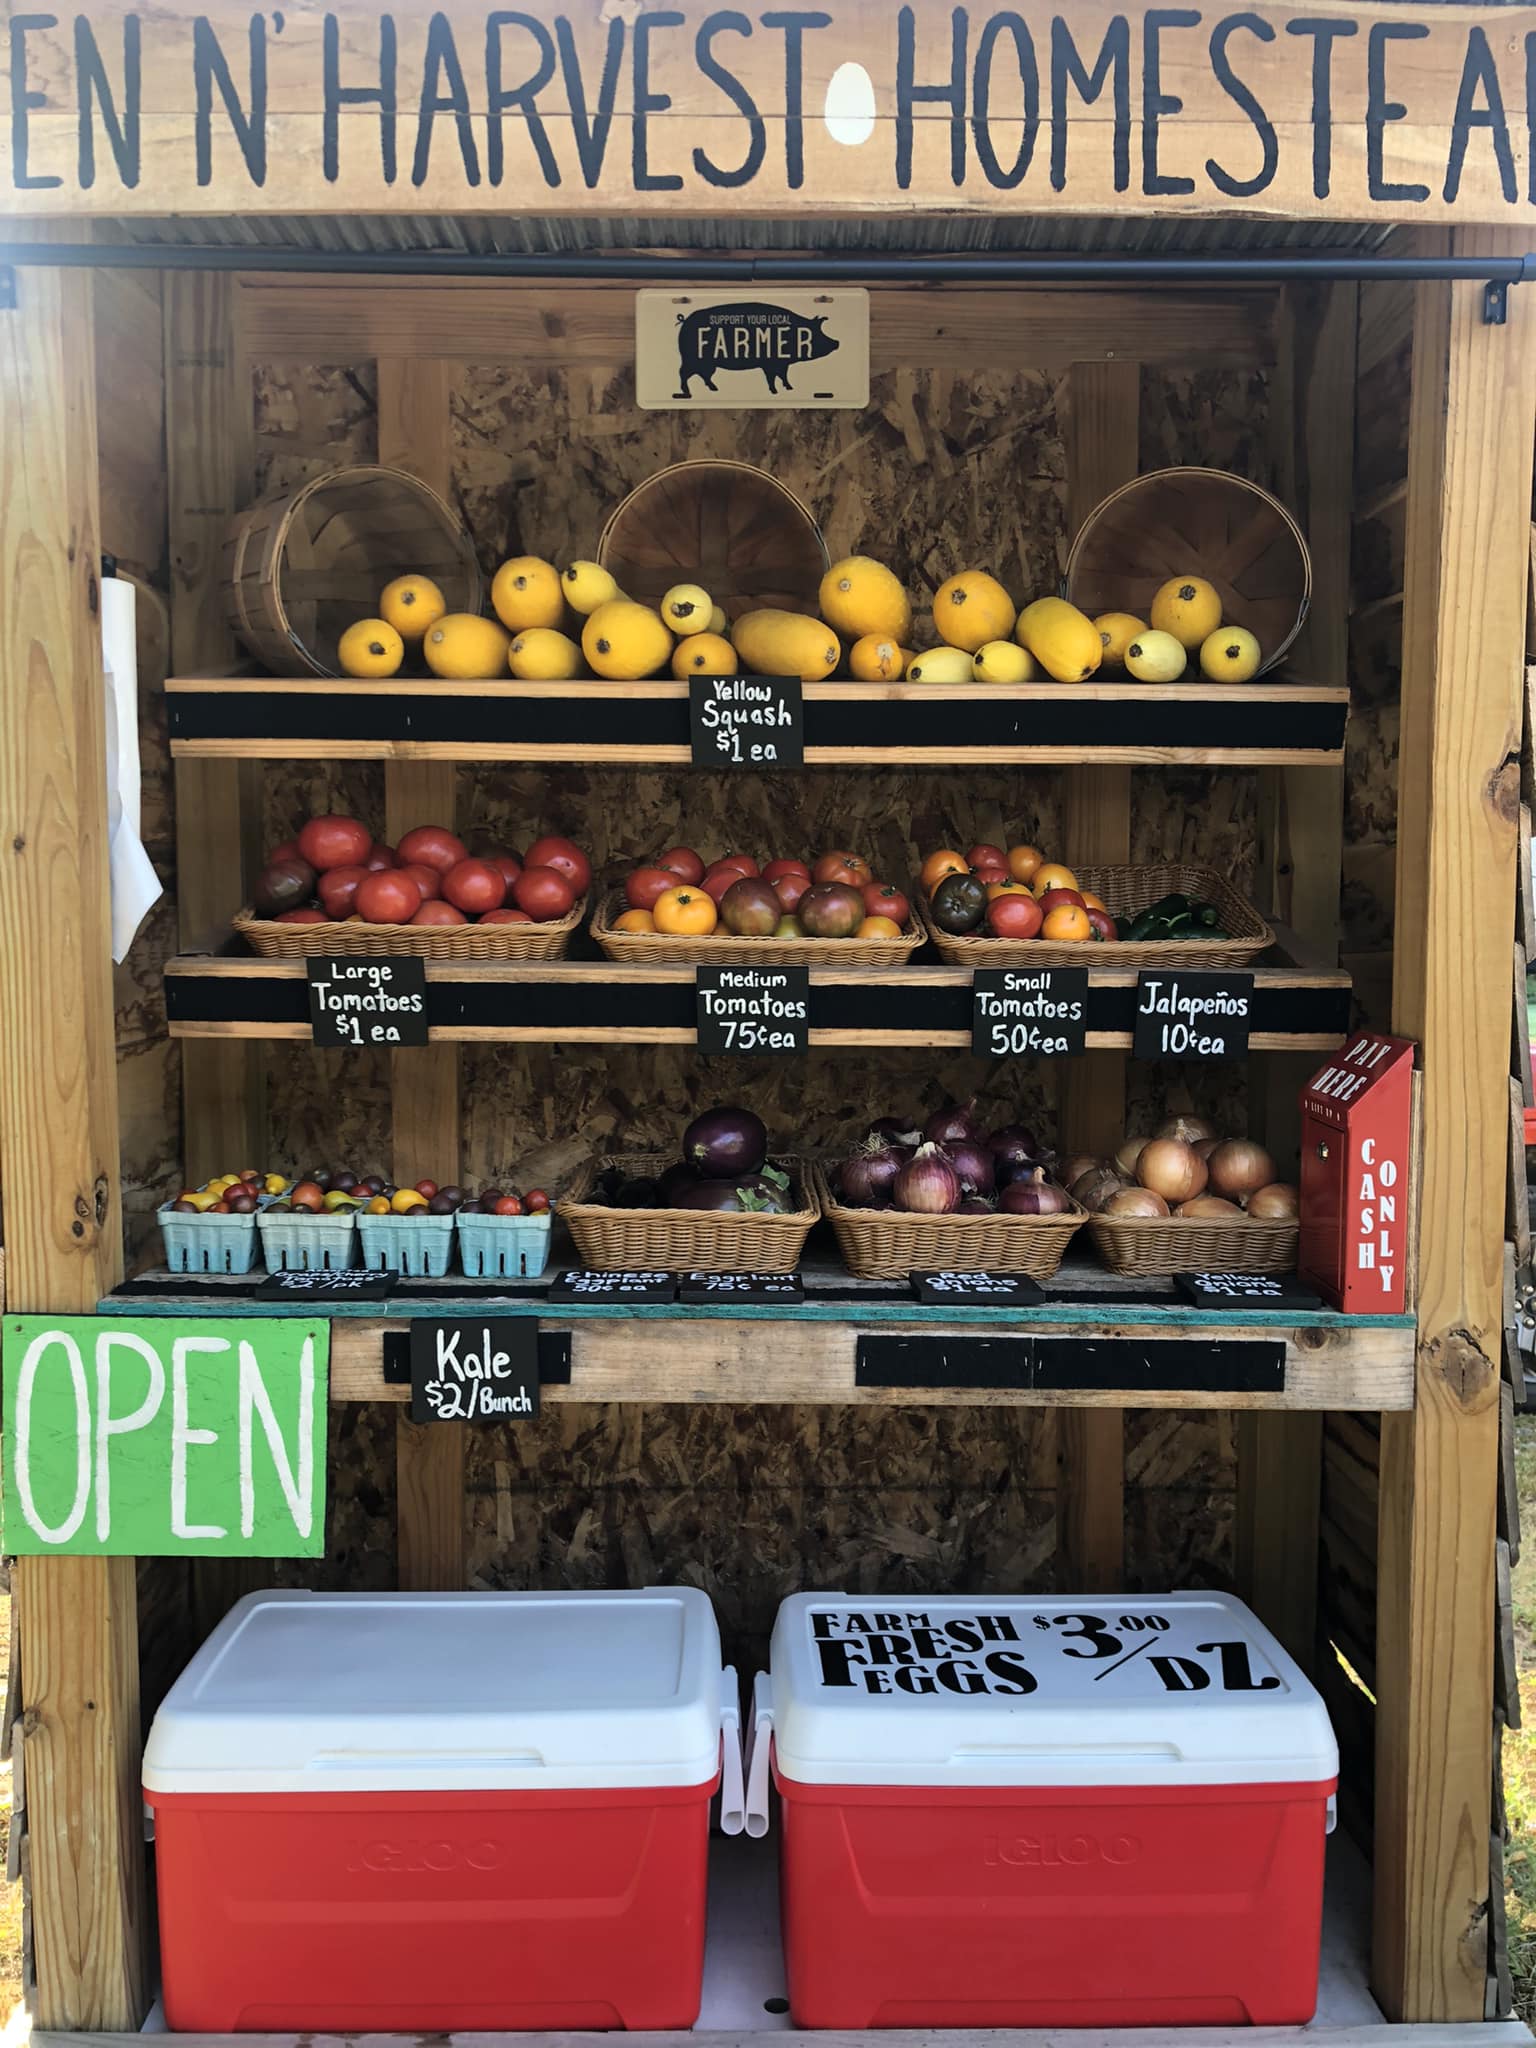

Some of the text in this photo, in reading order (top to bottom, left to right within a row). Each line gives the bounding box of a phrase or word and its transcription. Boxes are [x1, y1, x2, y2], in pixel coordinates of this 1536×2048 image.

[10, 13, 141, 190] EN
[322, 11, 833, 191] HARVEST
[896, 6, 1536, 204] HOMESTEA
[709, 314, 793, 326] SUPPORT YOUR LOCAL
[697, 327, 814, 359] FARMER
[713, 680, 771, 701] Yellow
[701, 699, 792, 735] Squash
[716, 730, 778, 762] $1 ea
[331, 963, 393, 988] Large
[719, 970, 787, 988] Medium
[1004, 973, 1051, 991] Small
[311, 982, 423, 1013] Tomatoes
[699, 989, 806, 1019] Tomatoes
[975, 992, 1082, 1021] Tomatoes
[1139, 981, 1248, 1026] Jalapeños
[335, 1013, 401, 1045] $1 ea
[1343, 1039, 1392, 1069] PAY
[1312, 1067, 1368, 1101] HERE
[1358, 1138, 1377, 1270] CASH
[1379, 1160, 1398, 1292] ONLY
[565, 1277, 666, 1286] Eggplant
[566, 1271, 669, 1279] Chinese
[690, 1272, 799, 1284] Eggplant
[765, 1284, 796, 1292] ea
[925, 1277, 1019, 1286] Onions
[939, 1272, 990, 1280] Red
[1194, 1279, 1282, 1288] Onions
[1195, 1272, 1267, 1281] Yellow
[436, 1328, 512, 1382] Kale
[14, 1330, 315, 1544] OPEN
[810, 1613, 931, 1638] FARM
[815, 1616, 1021, 1686] FRESH
[863, 1651, 1038, 1695] EGGS
[346, 1841, 504, 1872] IGLOO
[984, 1833, 1144, 1867] IGLOO
